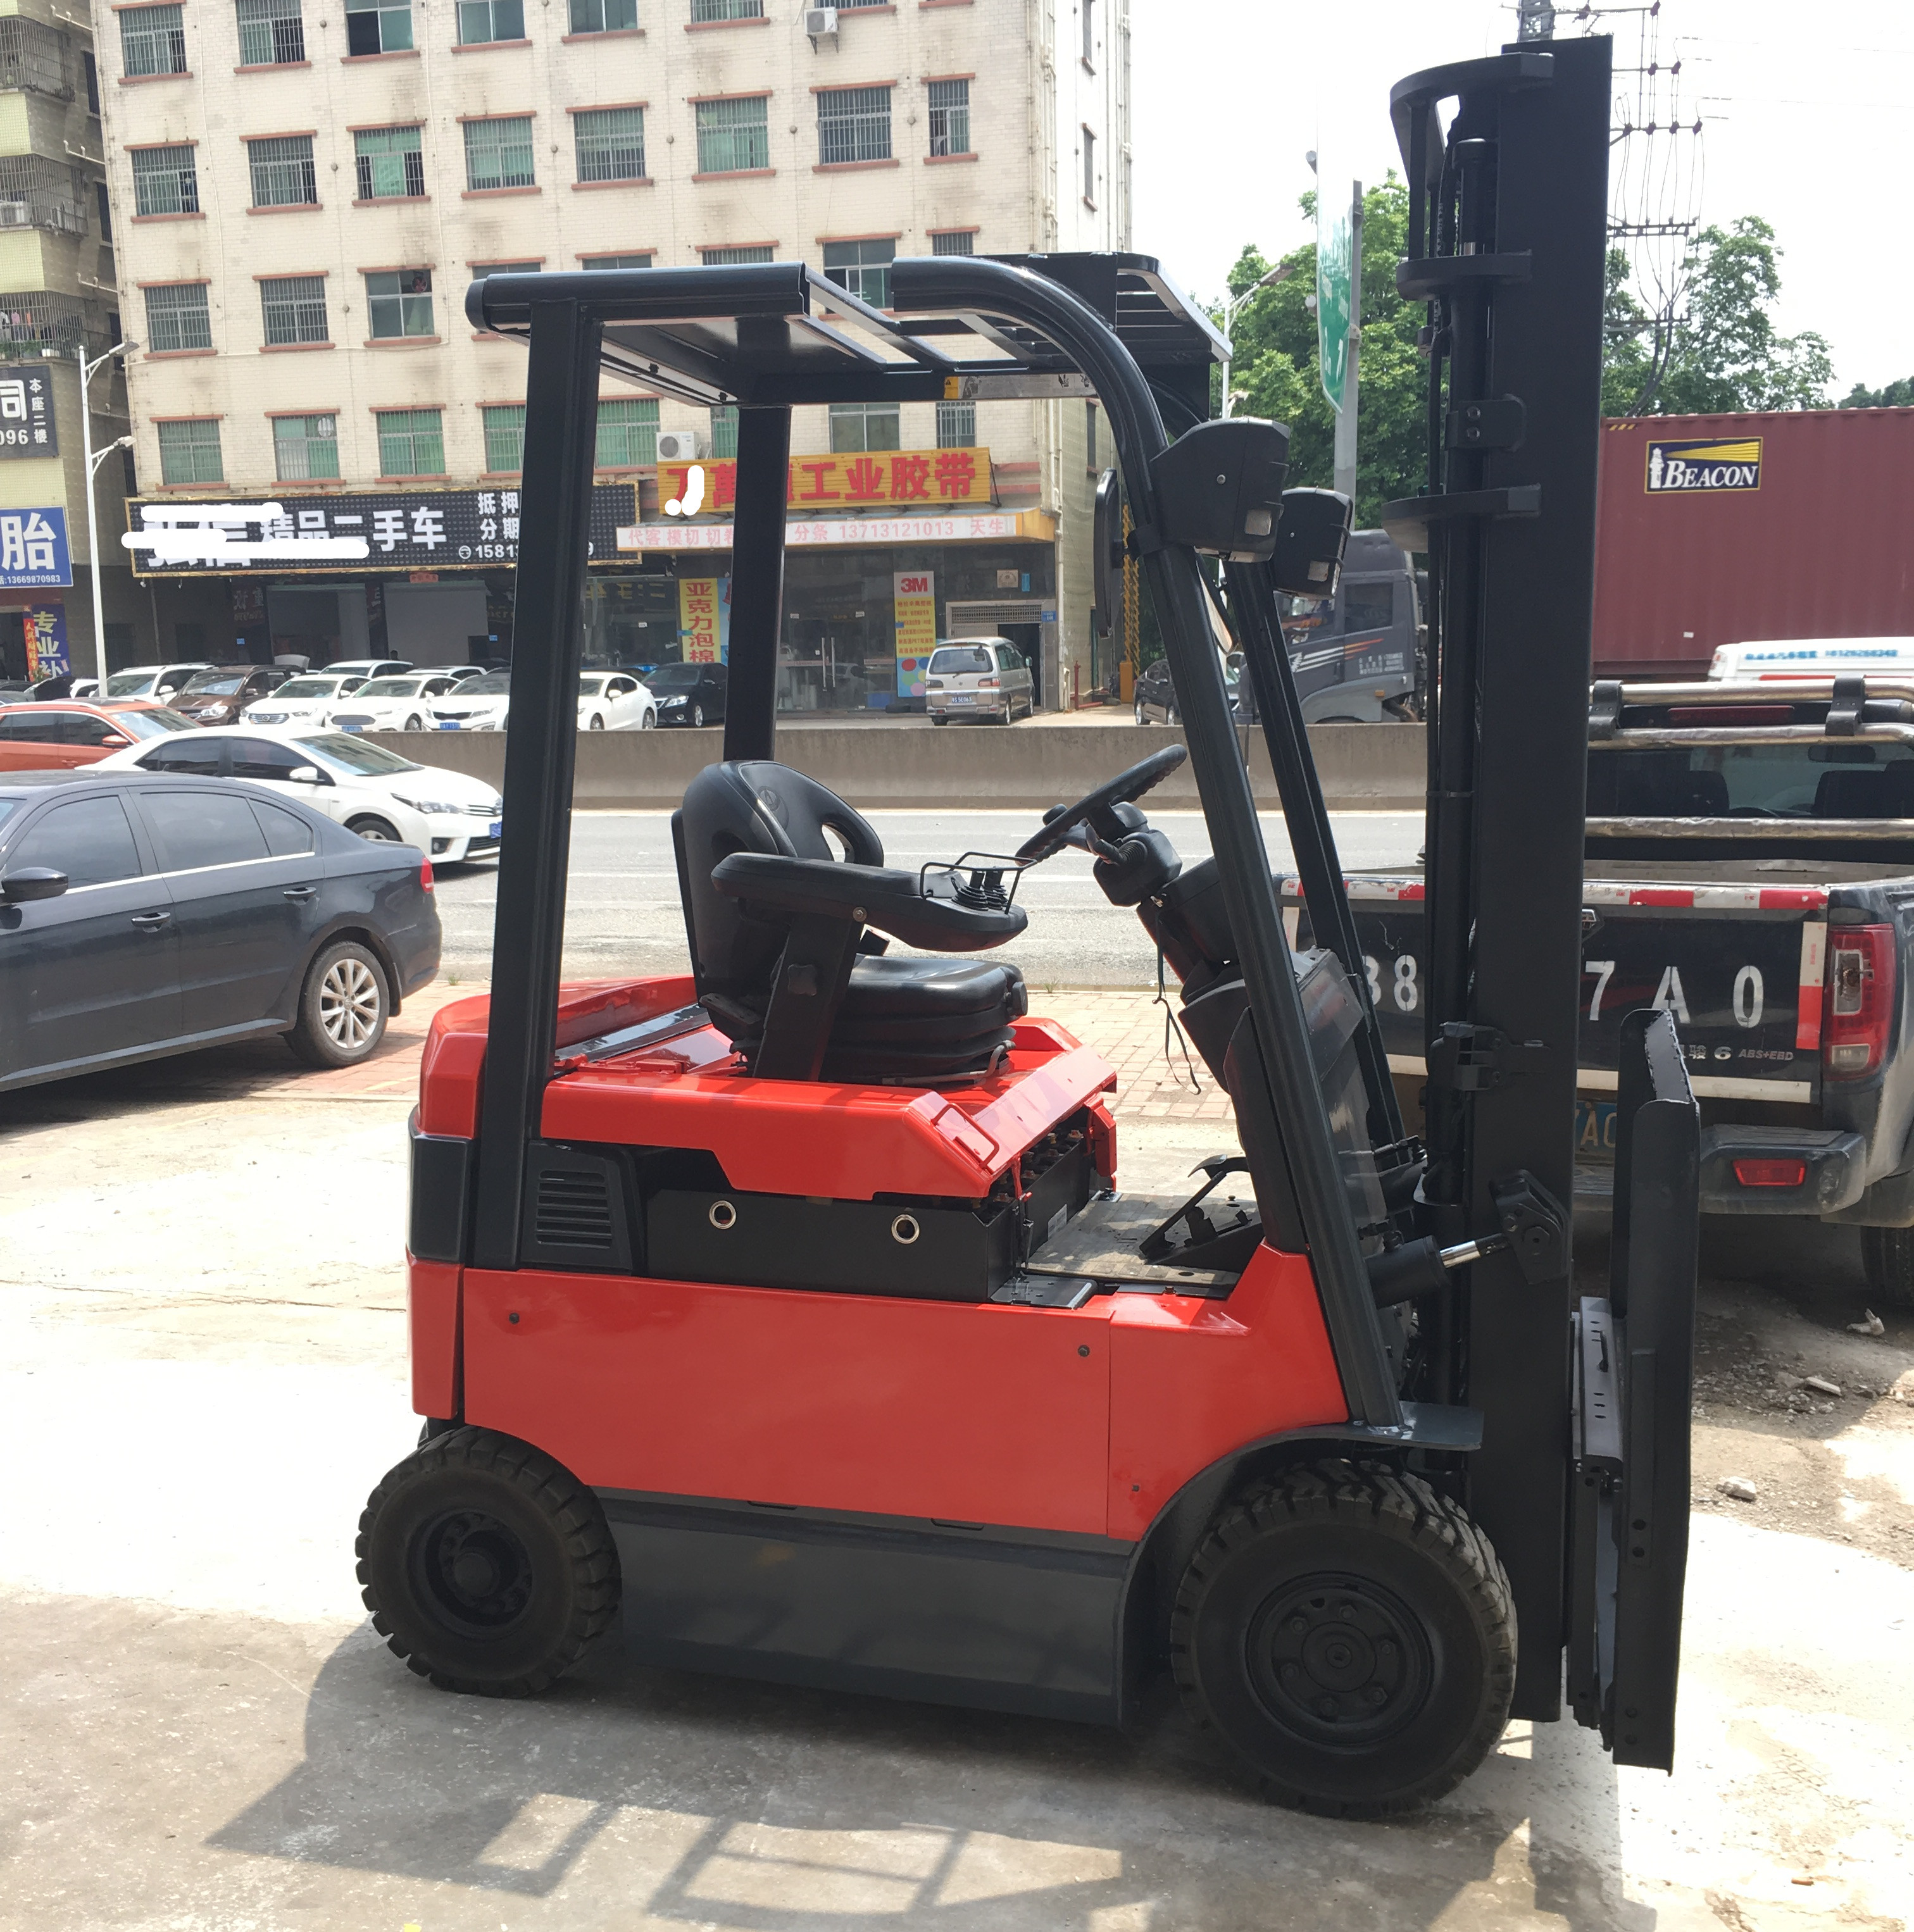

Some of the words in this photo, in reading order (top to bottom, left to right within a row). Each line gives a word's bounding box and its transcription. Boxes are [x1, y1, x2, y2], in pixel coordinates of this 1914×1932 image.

[1662, 460, 1758, 489] BEACON
[839, 521, 954, 539] 13713121013
[1, 512, 57, 571] 胎
[901, 577, 928, 593] 3M
[1714, 1046, 1732, 1060] 6
[1738, 1049, 1794, 1061] ABS+EBD
